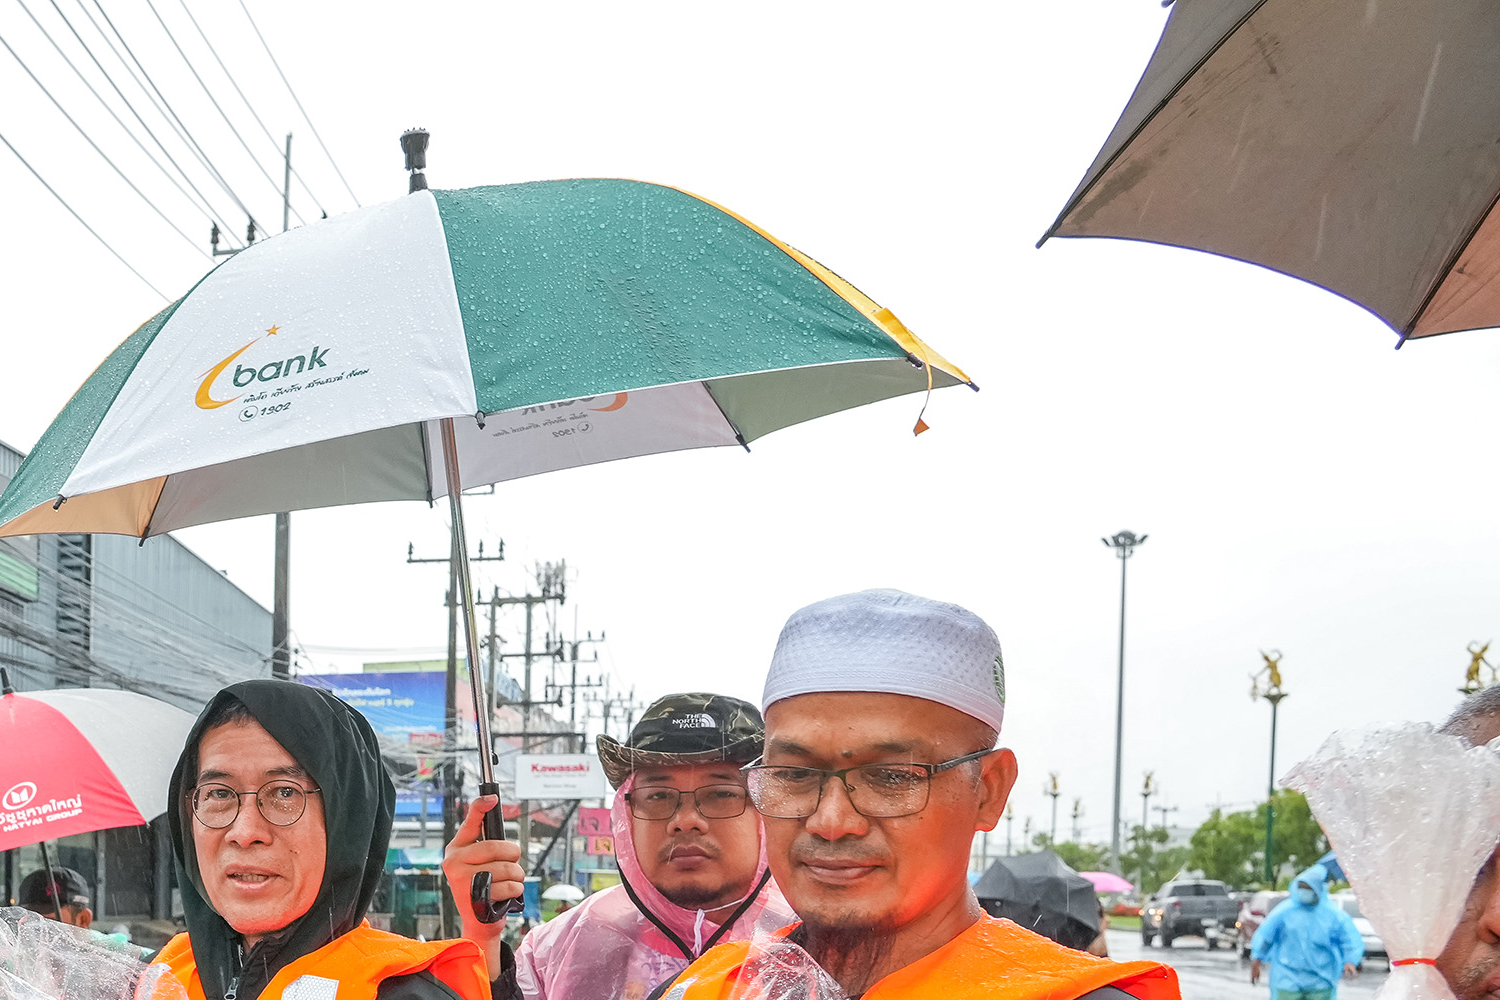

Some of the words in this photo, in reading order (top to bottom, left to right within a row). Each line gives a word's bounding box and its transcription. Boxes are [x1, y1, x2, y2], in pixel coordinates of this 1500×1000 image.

[232, 345, 331, 388] bank
[531, 761, 590, 773] Kawasaki
[3, 817, 43, 832] HATYAI
[46, 808, 83, 822] GROUP
